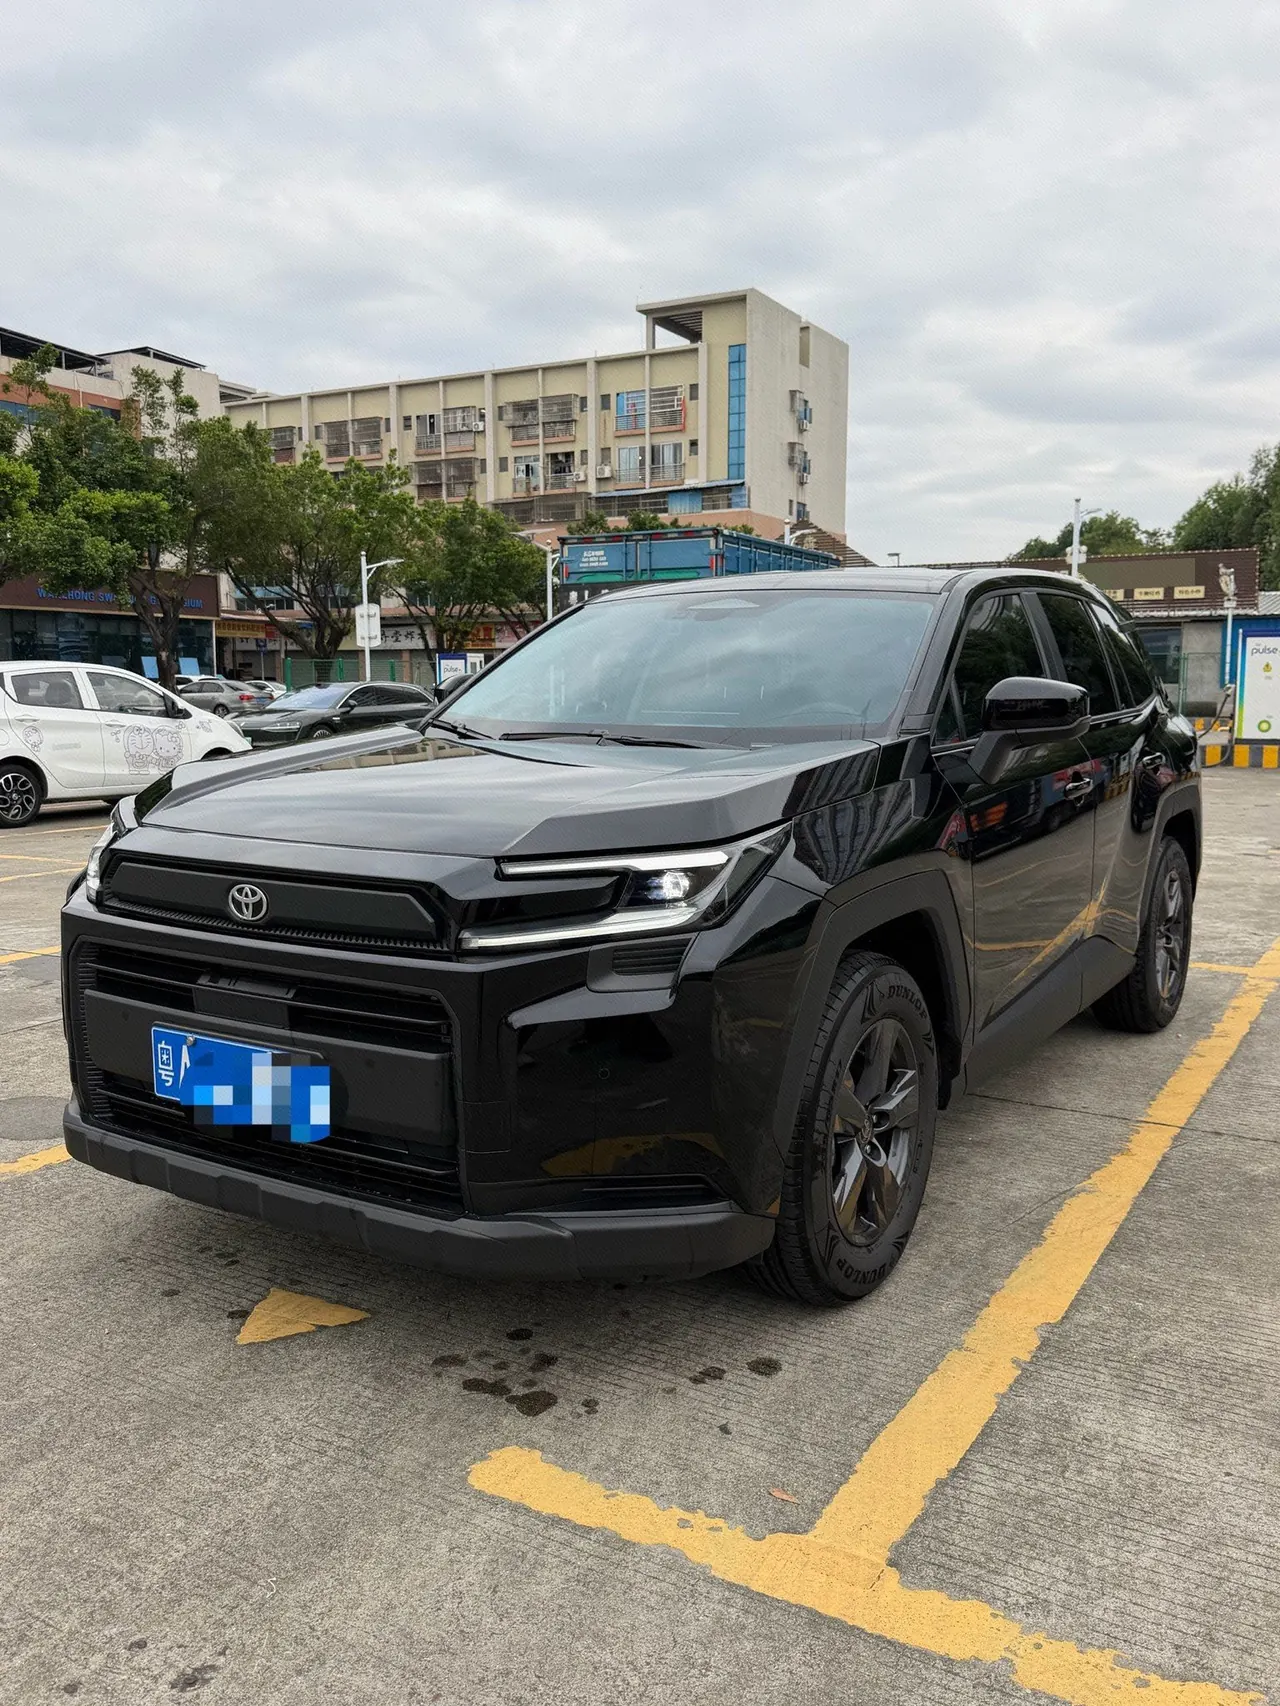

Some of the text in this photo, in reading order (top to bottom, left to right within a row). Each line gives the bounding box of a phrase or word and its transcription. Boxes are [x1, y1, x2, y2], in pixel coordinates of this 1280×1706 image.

[1251, 646, 1278, 656] pulse
[443, 664, 459, 673] pulse
[888, 985, 928, 1019] DUNLOP
[836, 1258, 887, 1285] DUNLOP
